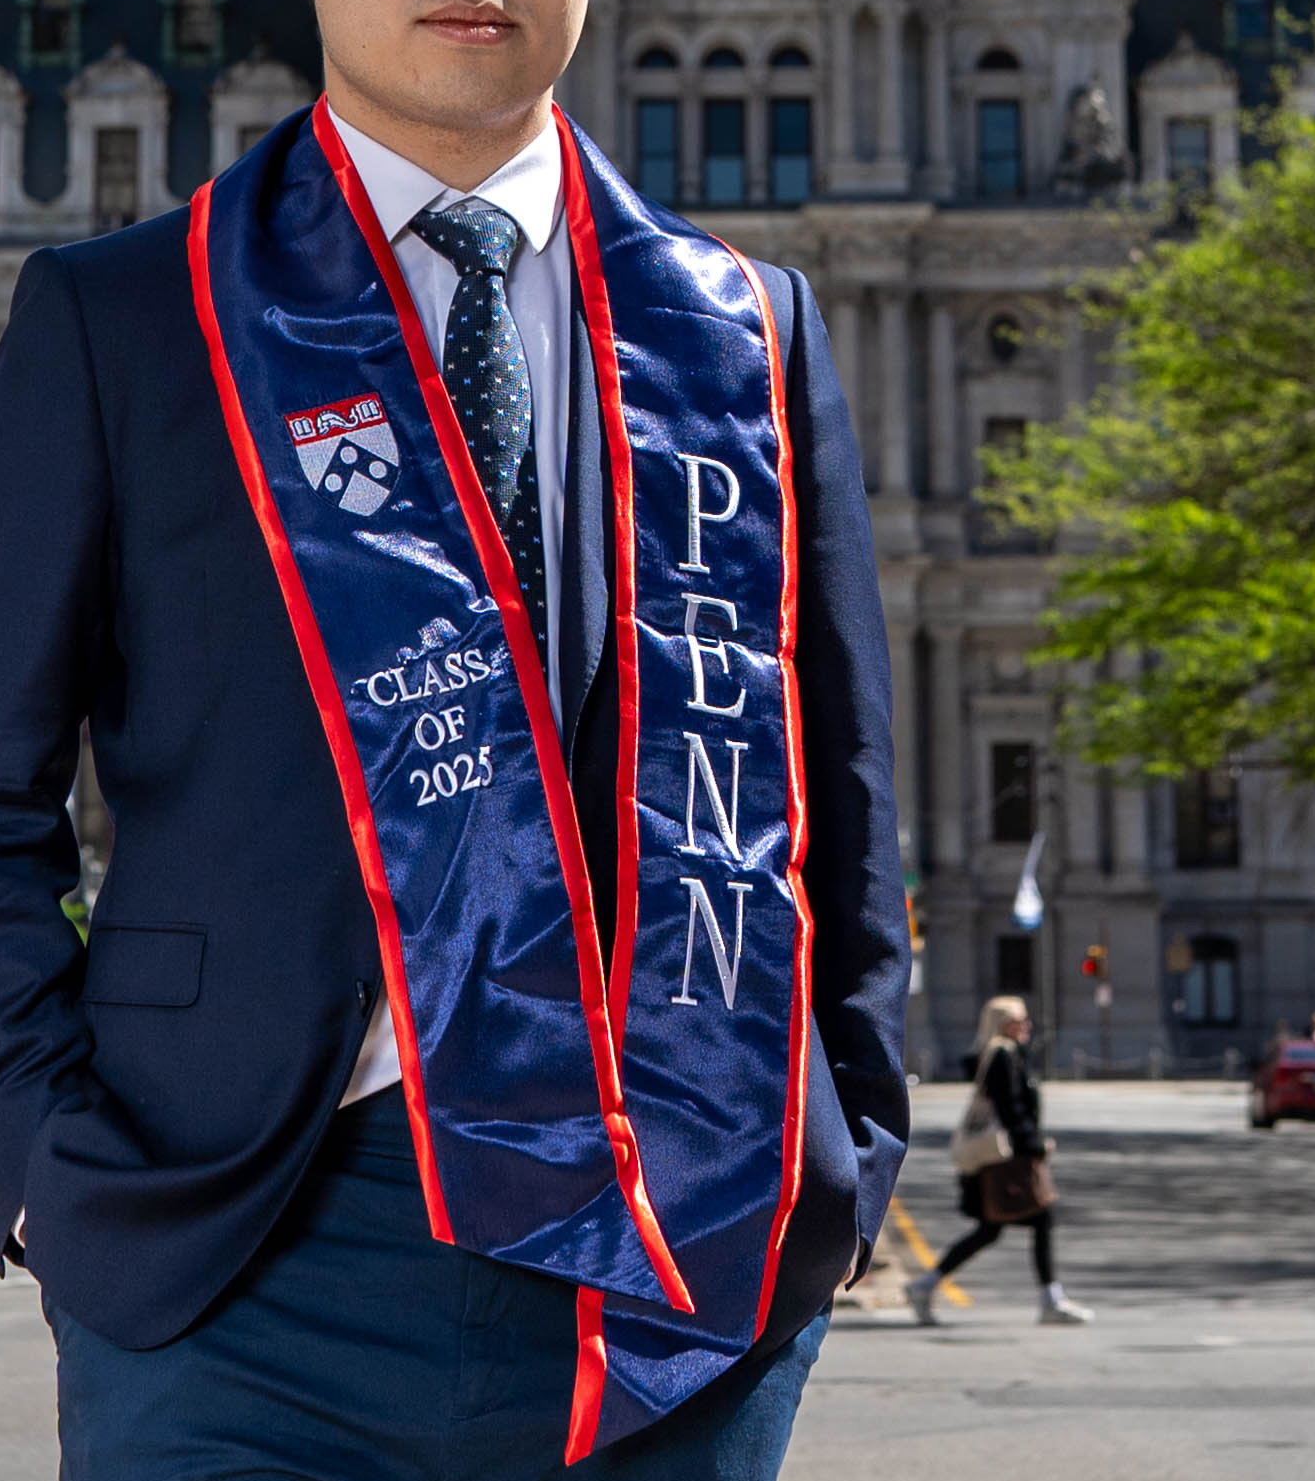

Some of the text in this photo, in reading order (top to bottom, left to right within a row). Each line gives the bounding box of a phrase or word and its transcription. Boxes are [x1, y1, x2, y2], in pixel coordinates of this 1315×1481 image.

[367, 648, 491, 707] CLASS
[415, 705, 466, 751] OF
[671, 453, 753, 1010] PENN
[409, 745, 493, 807] 2025
